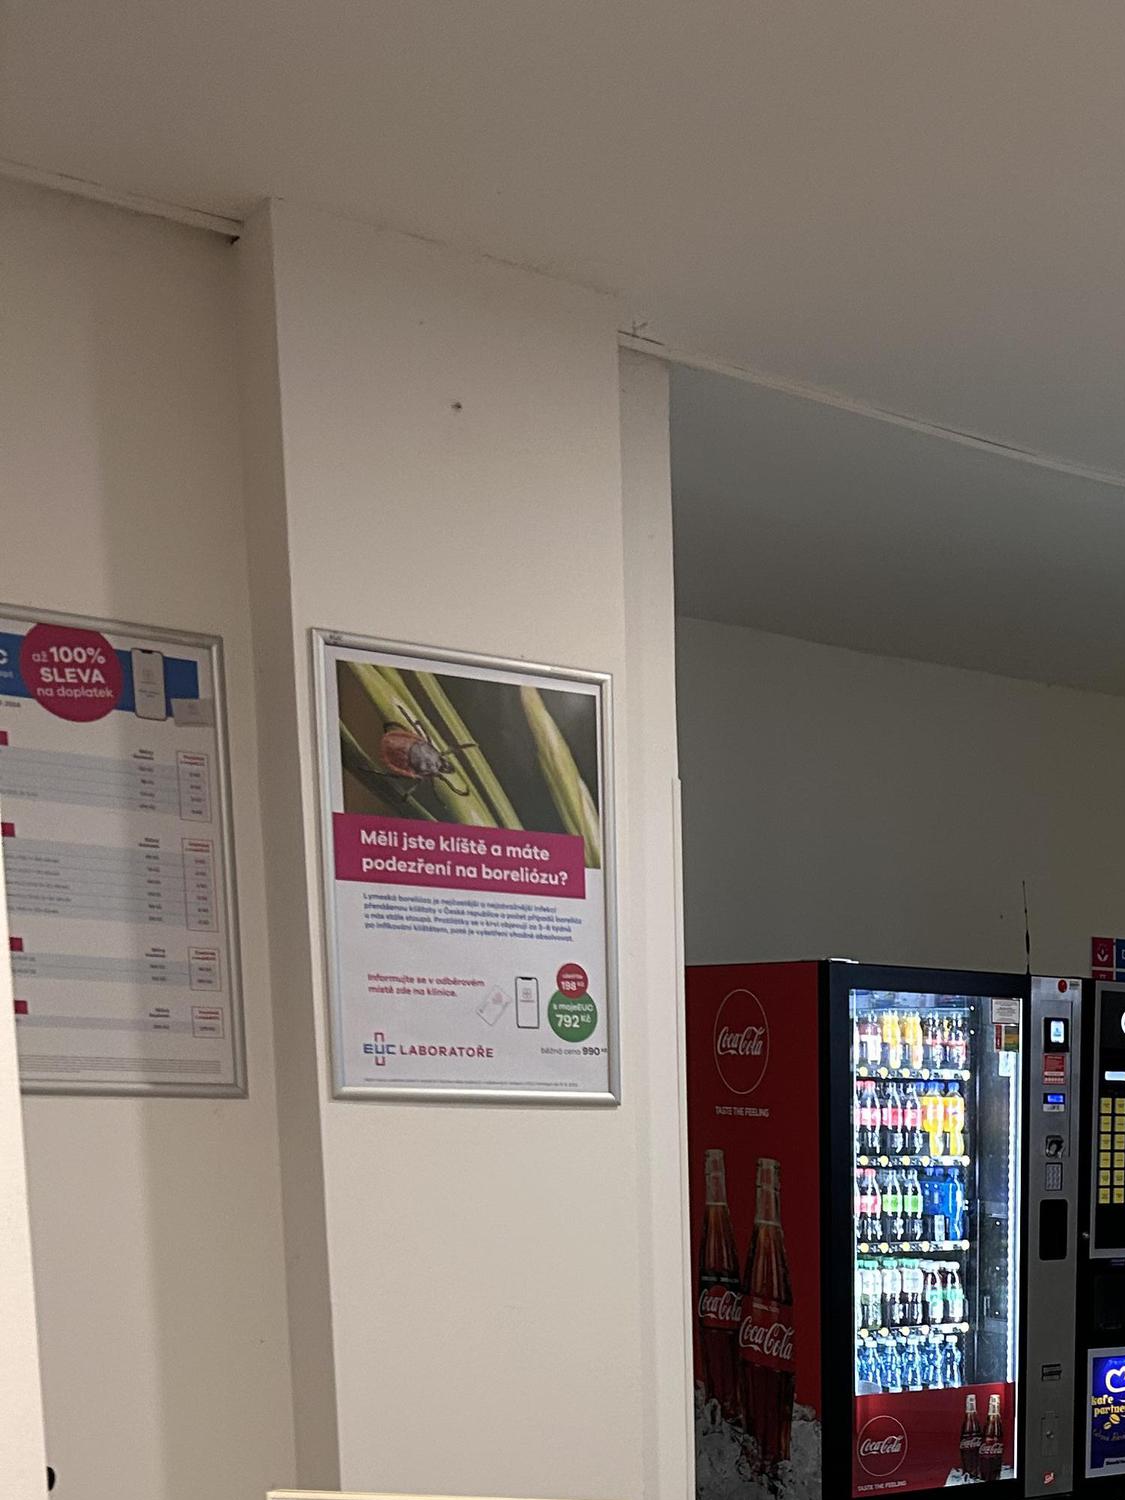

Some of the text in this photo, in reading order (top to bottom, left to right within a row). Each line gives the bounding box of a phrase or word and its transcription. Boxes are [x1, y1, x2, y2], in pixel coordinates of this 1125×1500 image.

[32, 646, 106, 665] až 100%
[40, 667, 105, 684] SLEVA
[37, 686, 114, 699] na doplatek
[361, 829, 550, 861] Měli jste klíště a máte
[362, 856, 568, 886] podezření na boreliózu?
[368, 973, 414, 985] Informujte
[435, 976, 485, 987] odběrovém
[555, 1014, 592, 1028] 792 Kč
[399, 1044, 494, 1058] LABORATOŘE
[582, 1046, 600, 1056] 990
[715, 1105, 769, 1118] TASTE THE FEELING
[1091, 1394, 1114, 1406] kafe
[857, 1480, 907, 1492] TASTE THE FEELING
